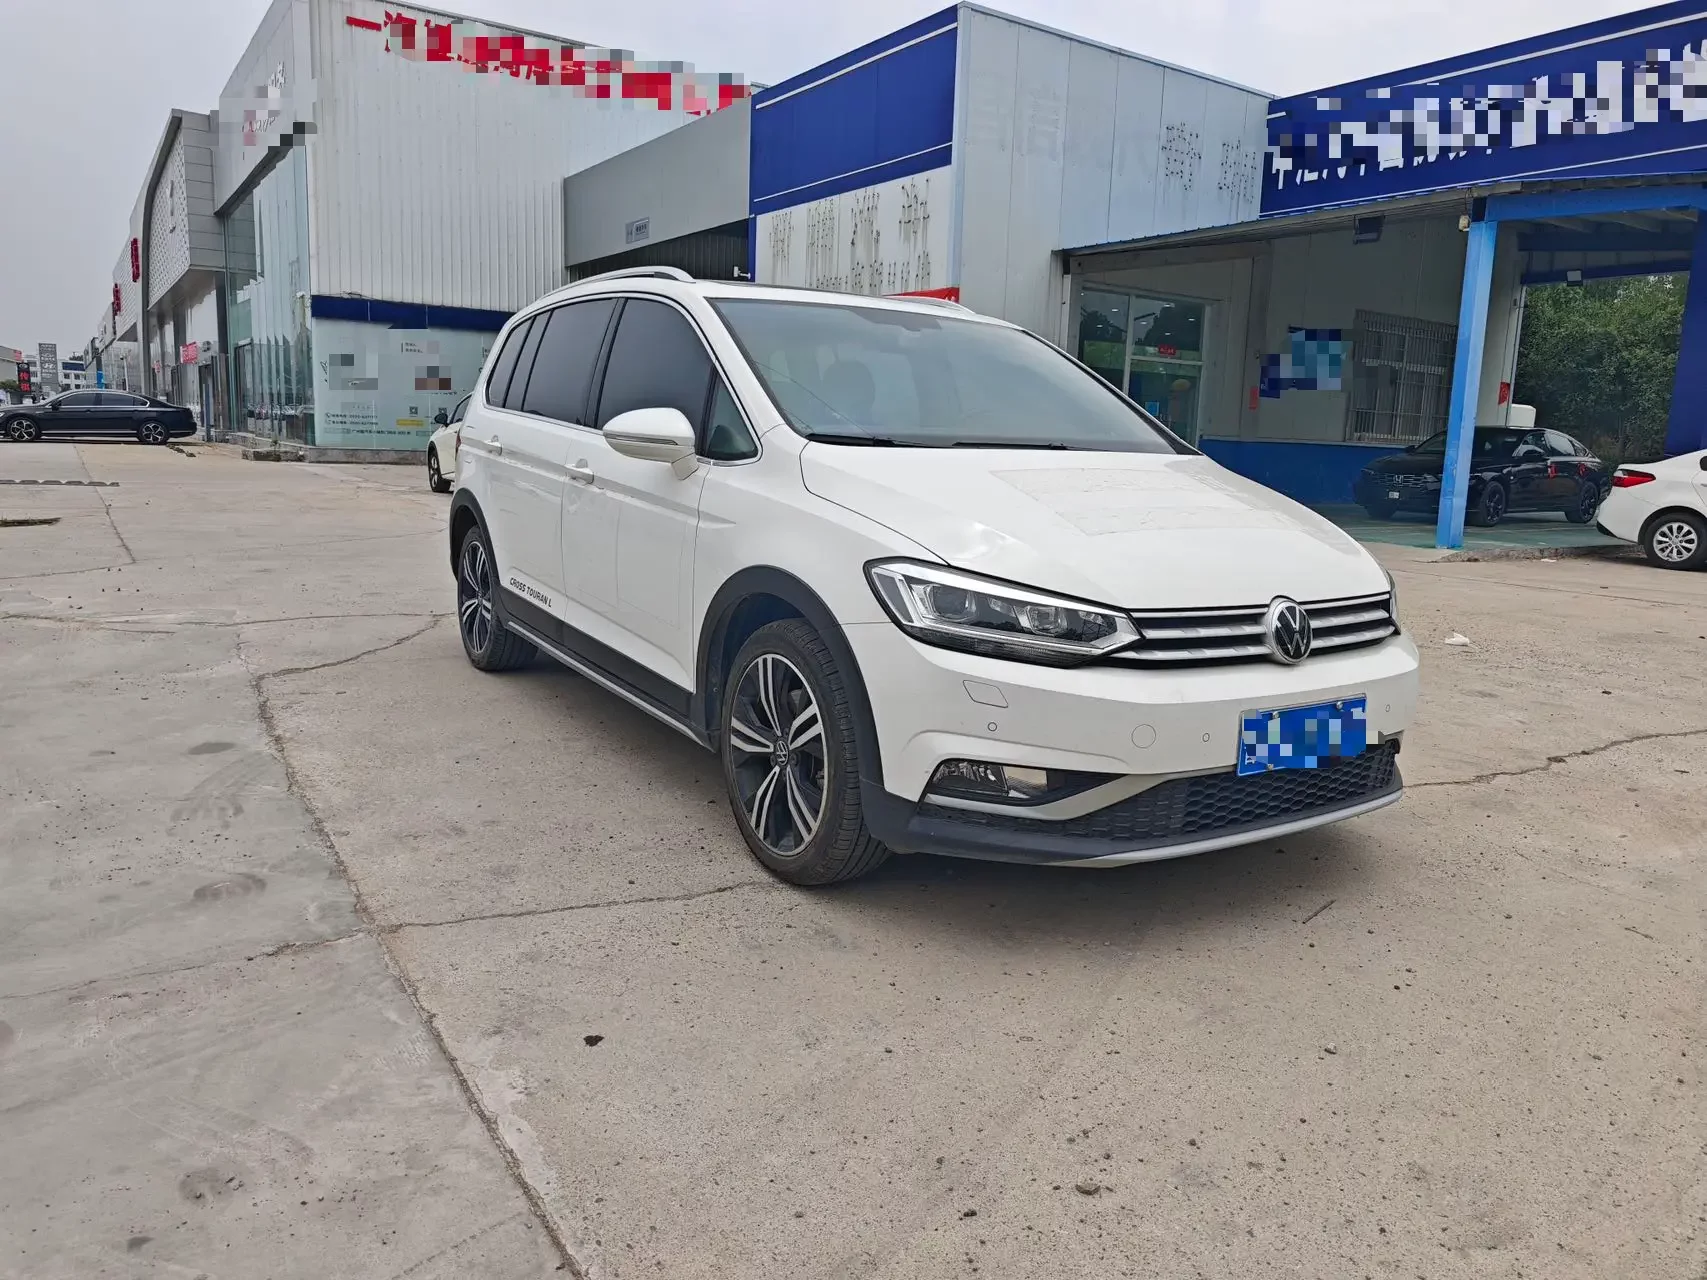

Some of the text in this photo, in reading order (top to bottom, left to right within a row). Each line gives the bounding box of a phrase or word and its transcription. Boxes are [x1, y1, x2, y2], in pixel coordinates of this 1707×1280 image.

[510, 577, 552, 607] CROSS TOURAN L
